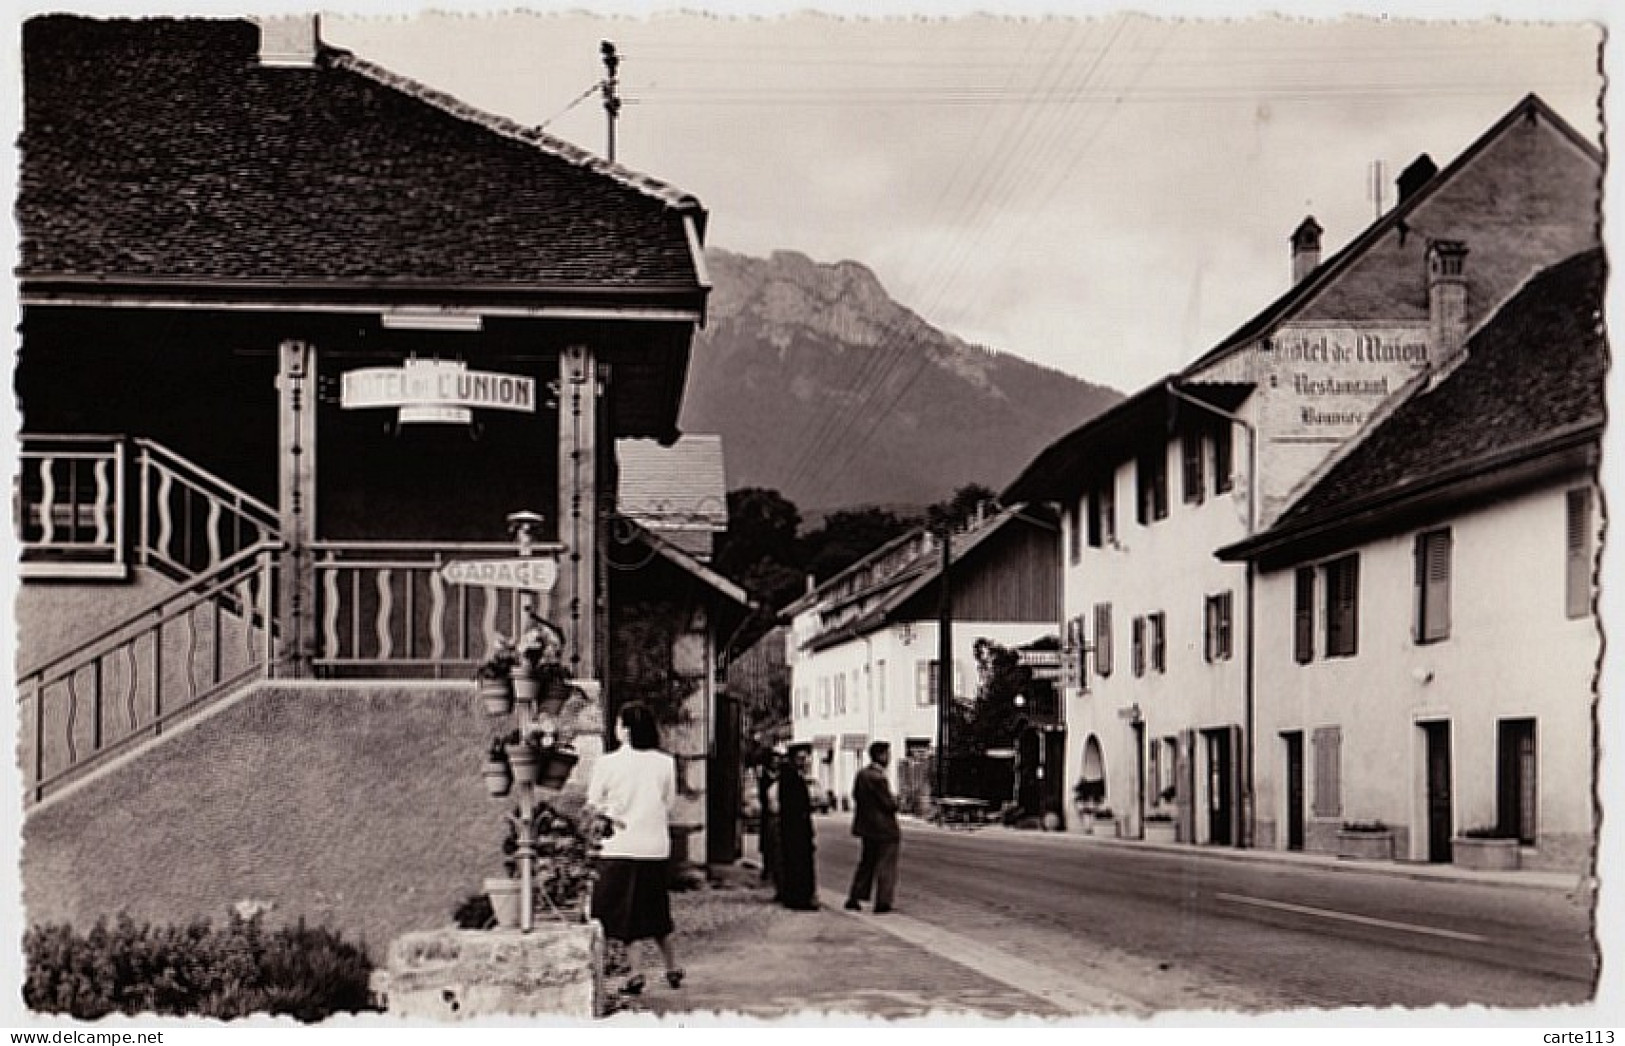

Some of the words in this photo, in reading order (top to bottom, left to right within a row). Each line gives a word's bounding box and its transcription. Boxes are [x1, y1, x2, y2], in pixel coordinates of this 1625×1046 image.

[1332, 342, 1352, 362] de
[438, 374, 530, 407] L'UNION
[1294, 373, 1388, 396] Restaurant
[447, 562, 550, 584] GARAGE
